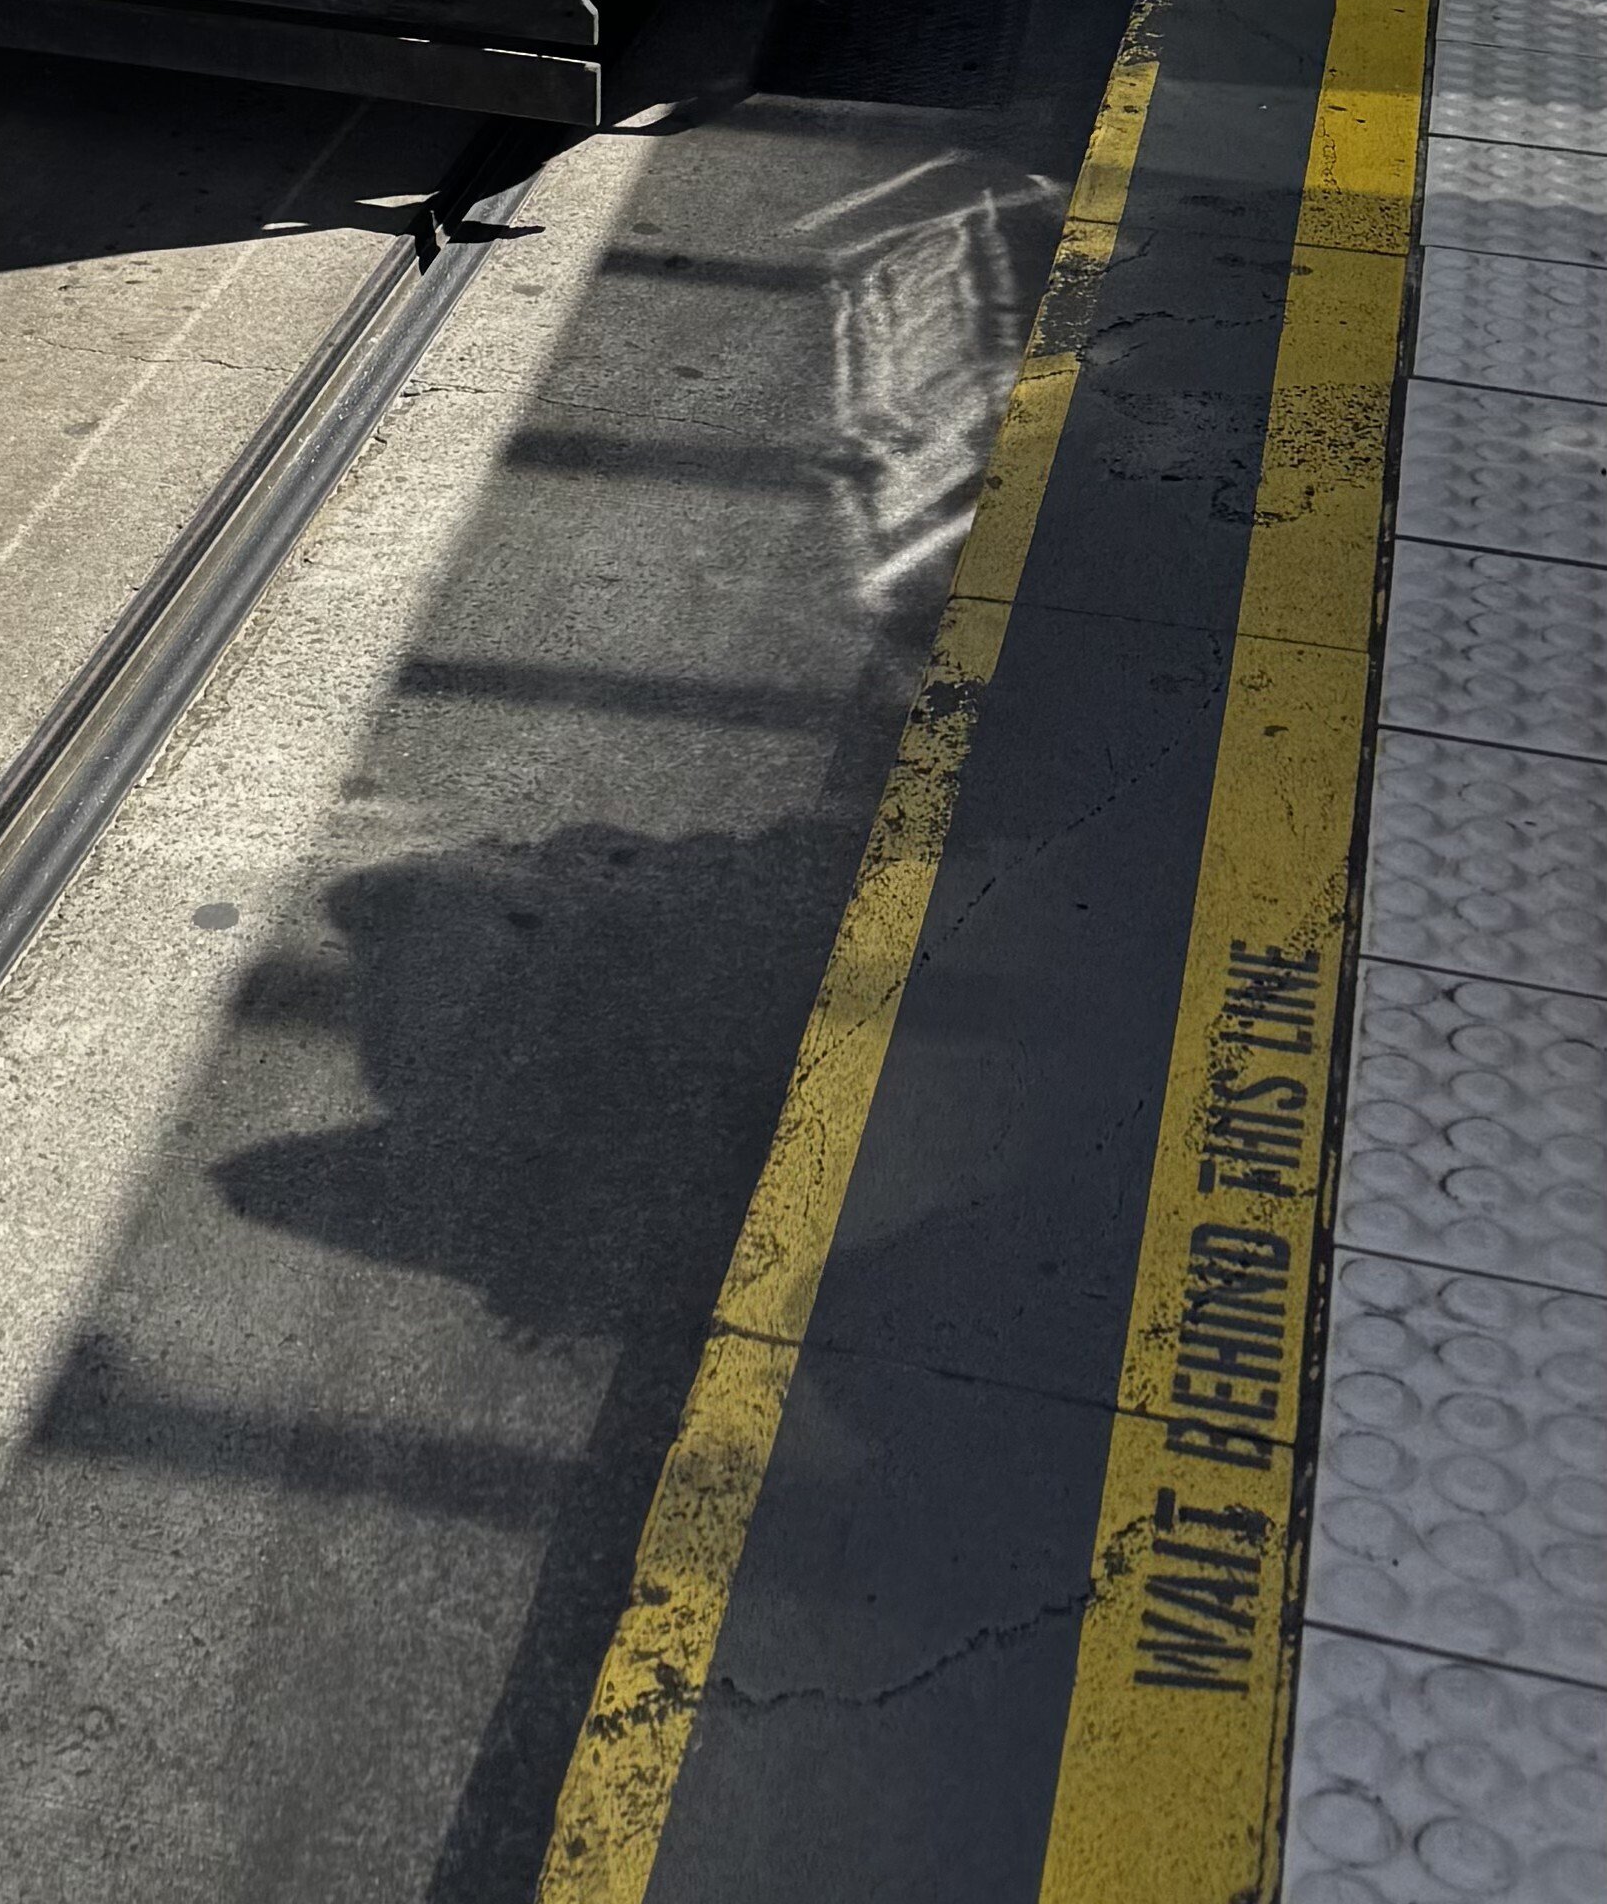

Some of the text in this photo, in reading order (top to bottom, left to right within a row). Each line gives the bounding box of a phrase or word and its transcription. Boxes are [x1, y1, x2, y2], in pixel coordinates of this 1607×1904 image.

[1133, 939, 1322, 1692] WAIT BEHIND THIS LINE
